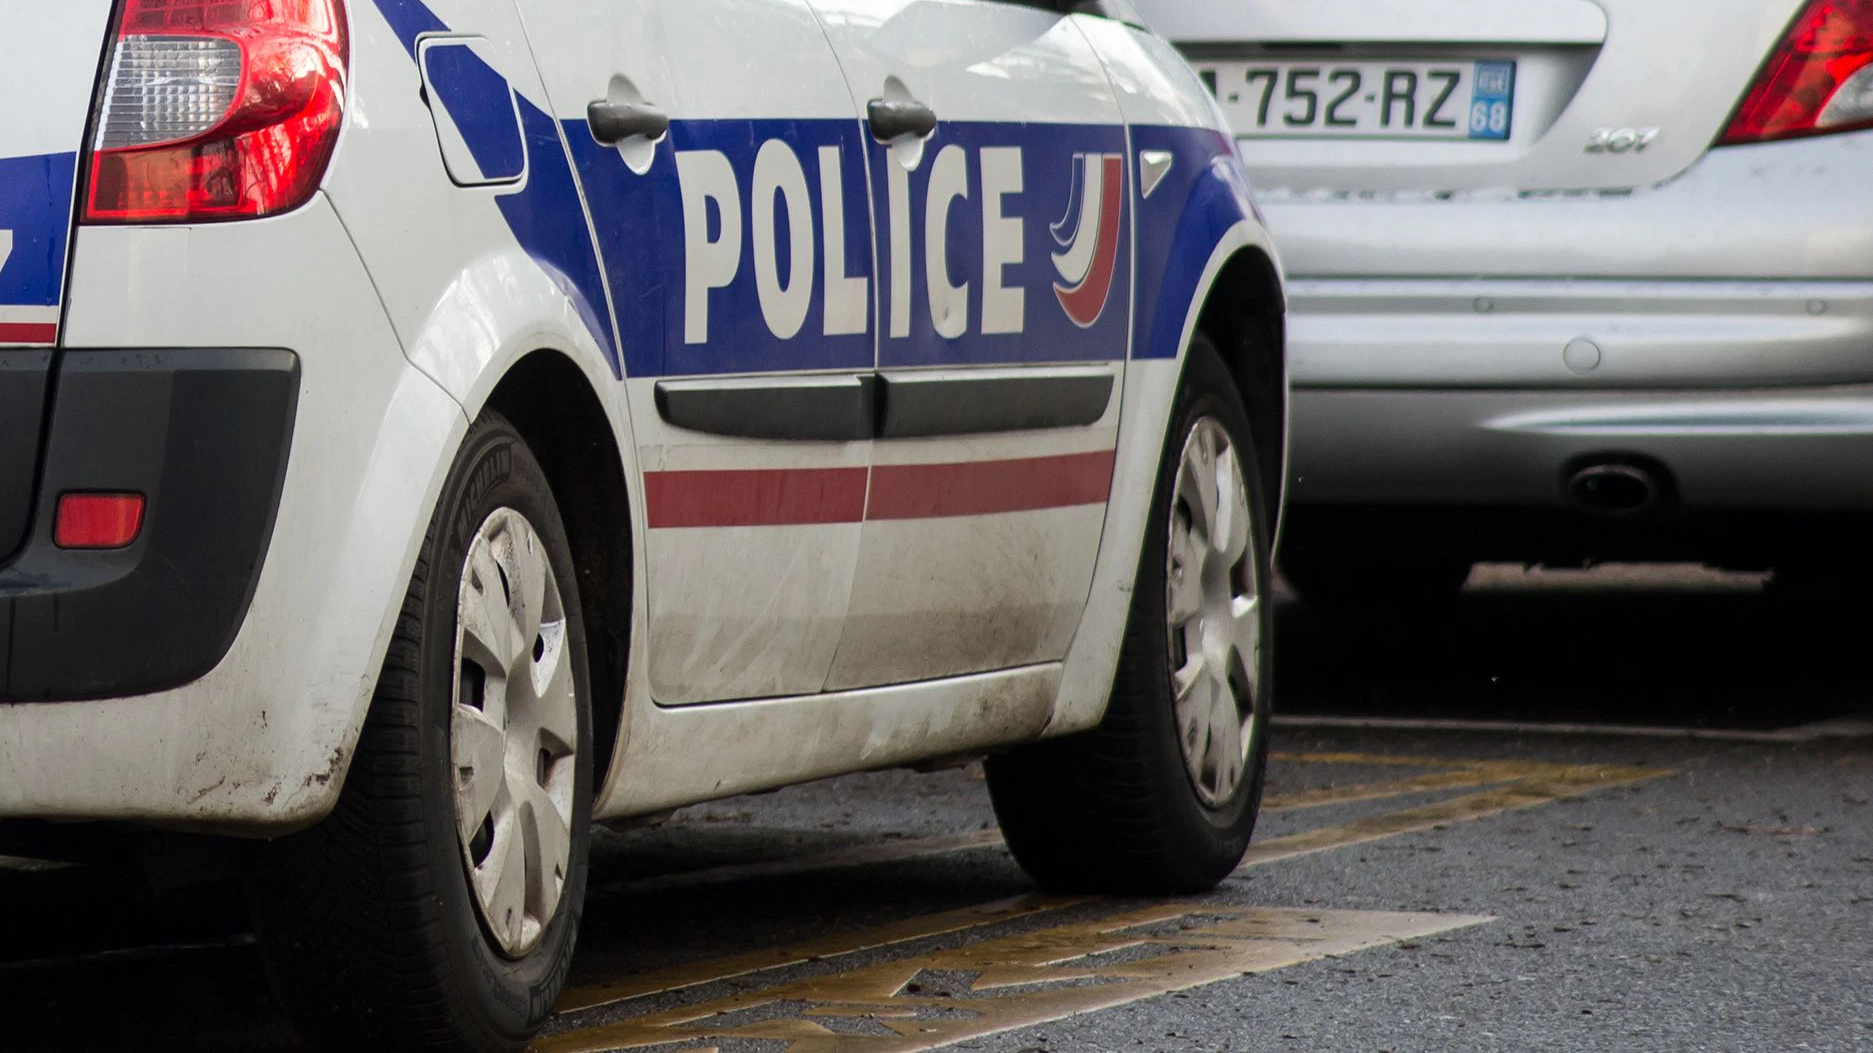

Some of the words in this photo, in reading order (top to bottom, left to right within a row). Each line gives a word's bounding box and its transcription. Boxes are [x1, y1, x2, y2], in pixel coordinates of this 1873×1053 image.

[1470, 101, 1506, 134] 68
[1583, 126, 1665, 153] 207
[674, 138, 1025, 345] POLICE
